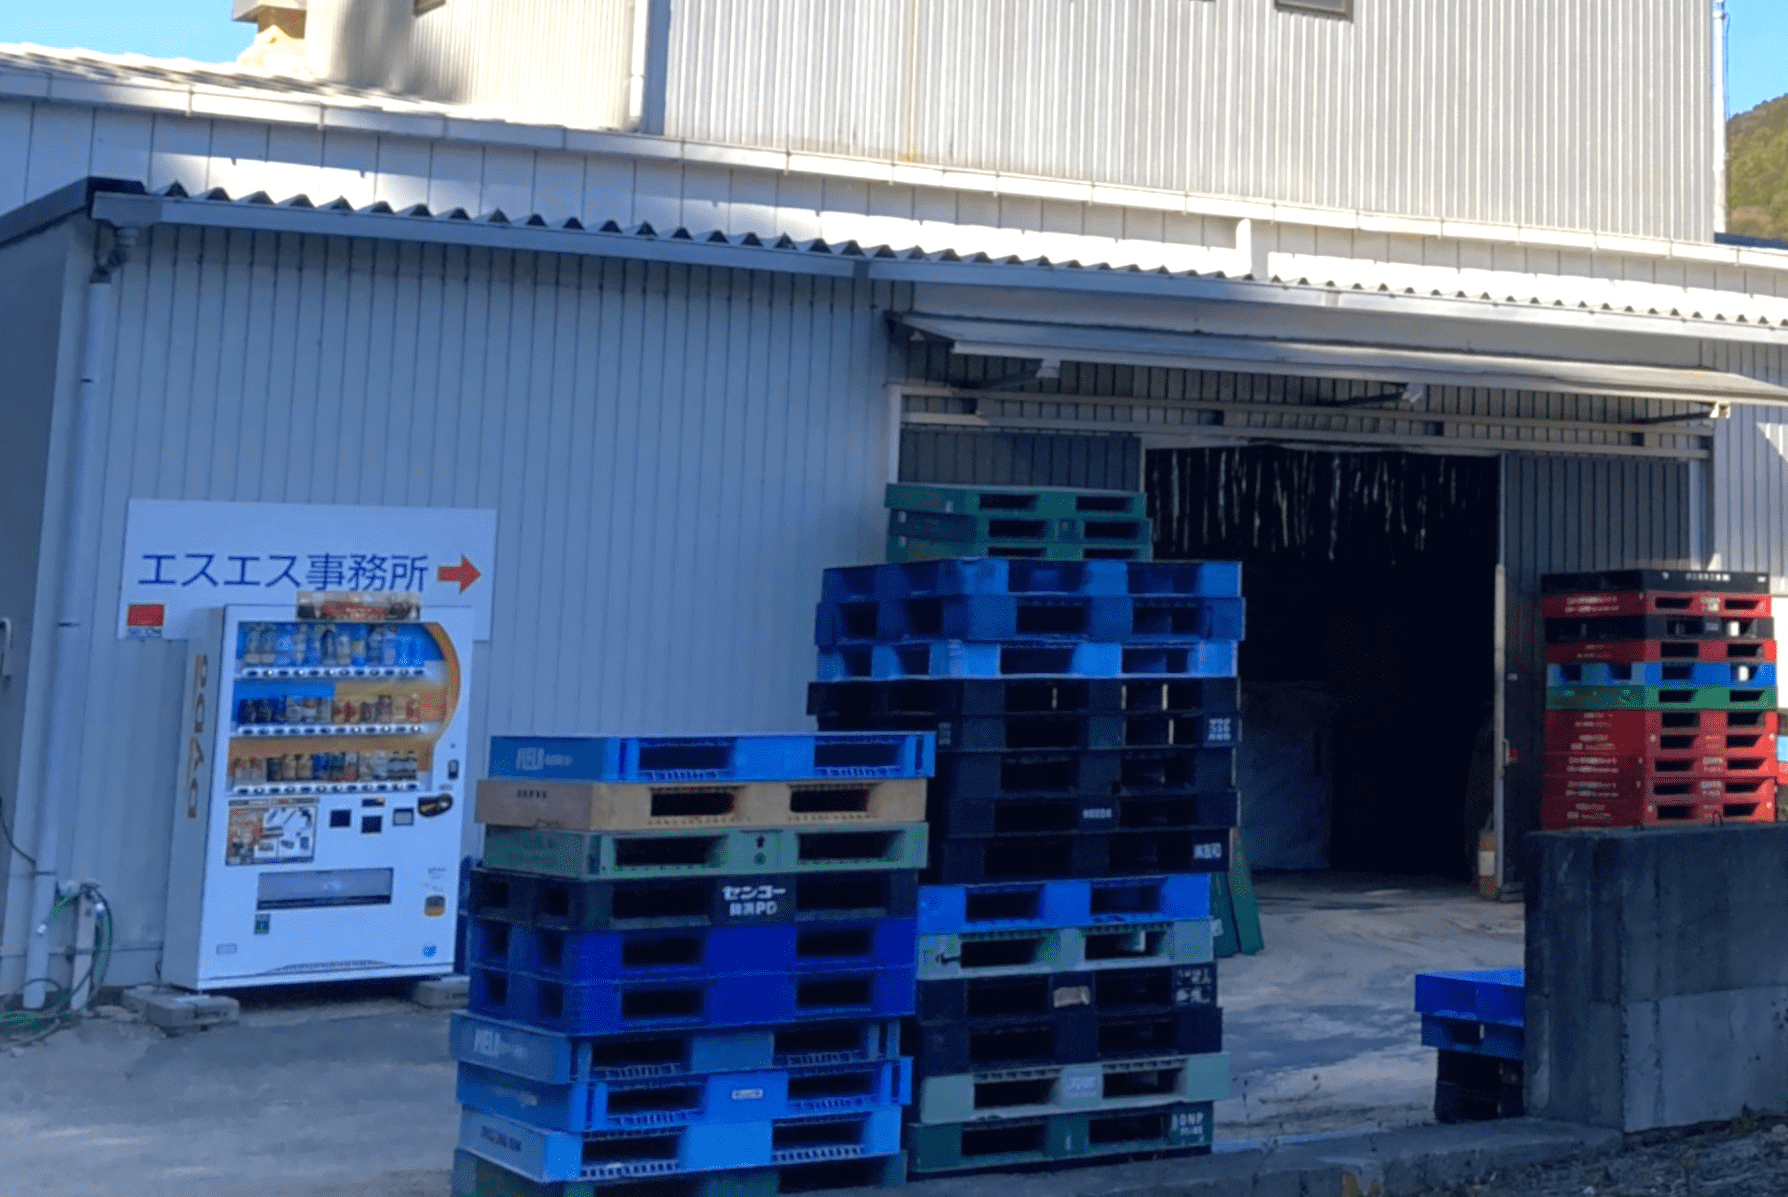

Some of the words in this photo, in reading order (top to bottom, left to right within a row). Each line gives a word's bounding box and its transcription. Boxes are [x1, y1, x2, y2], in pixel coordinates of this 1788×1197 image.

[137, 552, 429, 592] エスエス事務所
